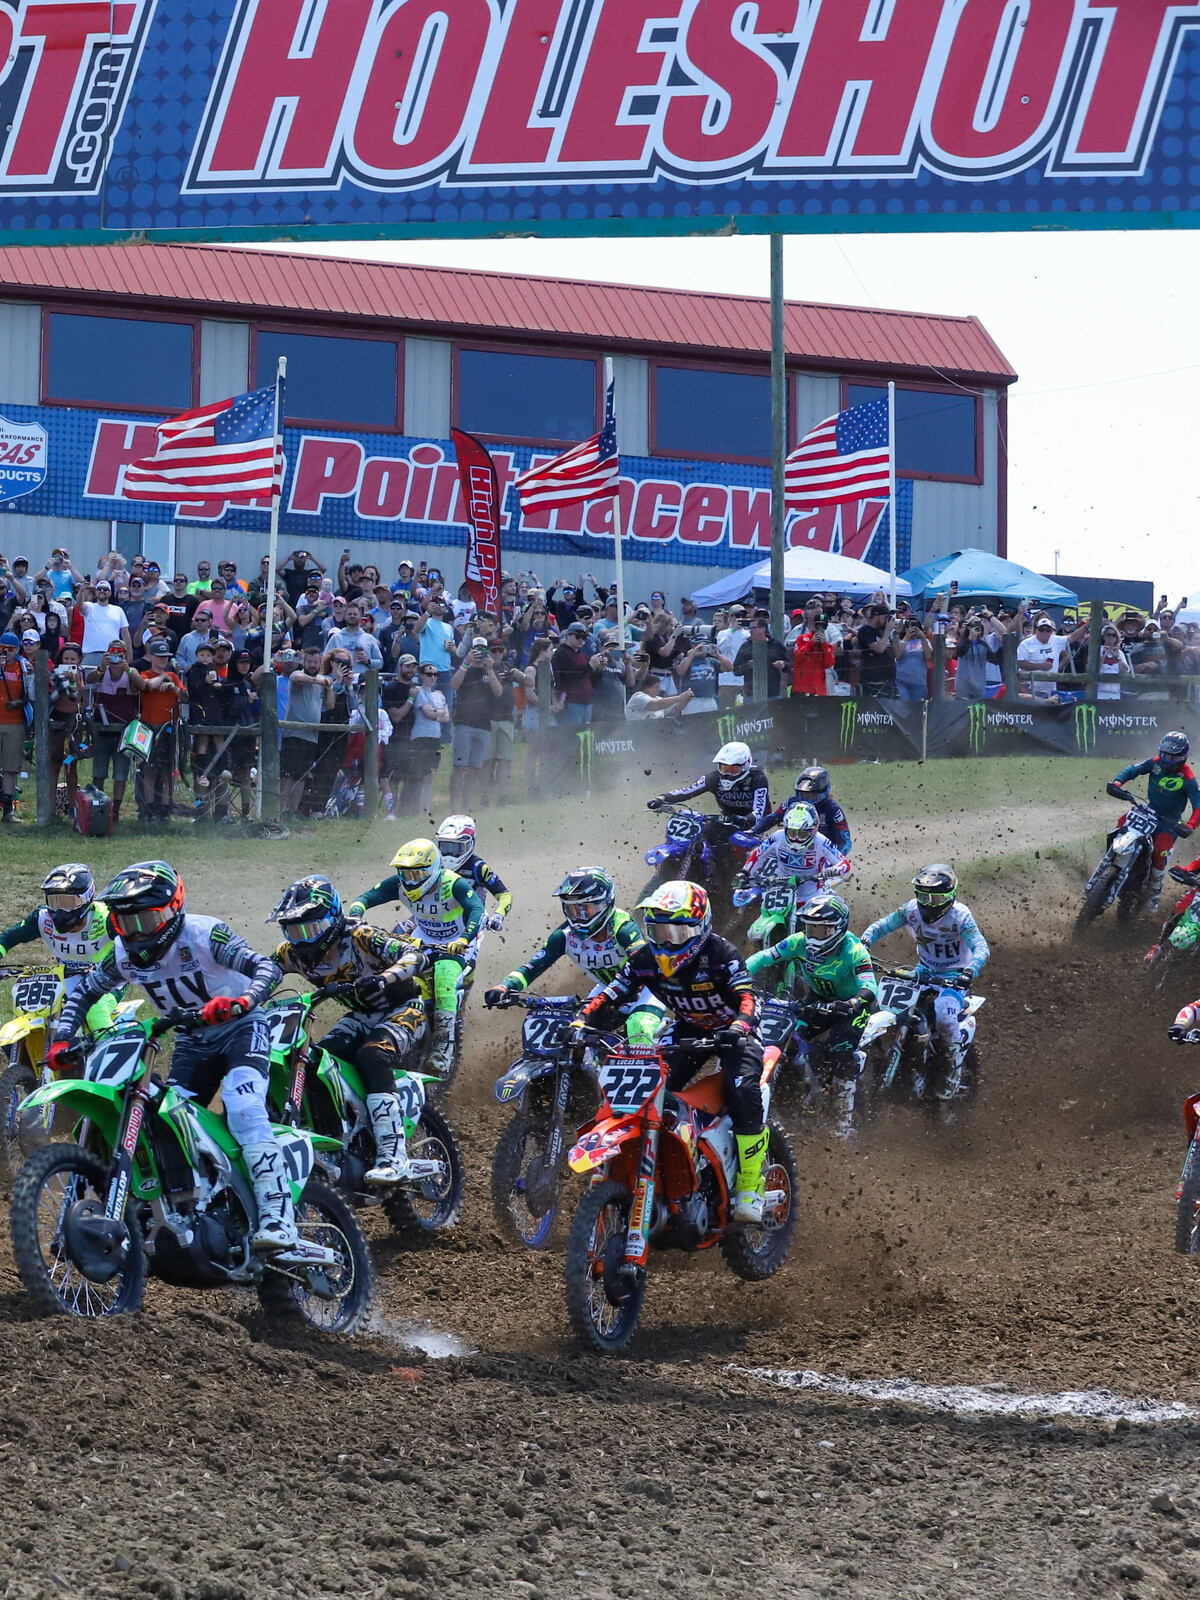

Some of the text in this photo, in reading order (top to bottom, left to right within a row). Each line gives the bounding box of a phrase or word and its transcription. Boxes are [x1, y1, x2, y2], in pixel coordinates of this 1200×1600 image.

[199, 0, 1200, 186] HOLESHOT
[287, 435, 520, 530] Point
[987, 712, 1034, 726] MONSTER
[1098, 714, 1158, 729] MONSTER
[764, 888, 789, 908] 65
[934, 940, 960, 959] FLY
[16, 982, 57, 1007] 285
[145, 969, 212, 1010] FLY
[880, 983, 908, 1009] 12
[88, 1041, 140, 1083] 17
[236, 1080, 256, 1097] FLY
[602, 1068, 663, 1105] 222
[123, 1105, 143, 1152] SHOWA
[282, 1146, 311, 1187] 17
[113, 1169, 128, 1221] DUNLOP
[643, 1182, 655, 1224] MOTOREX
